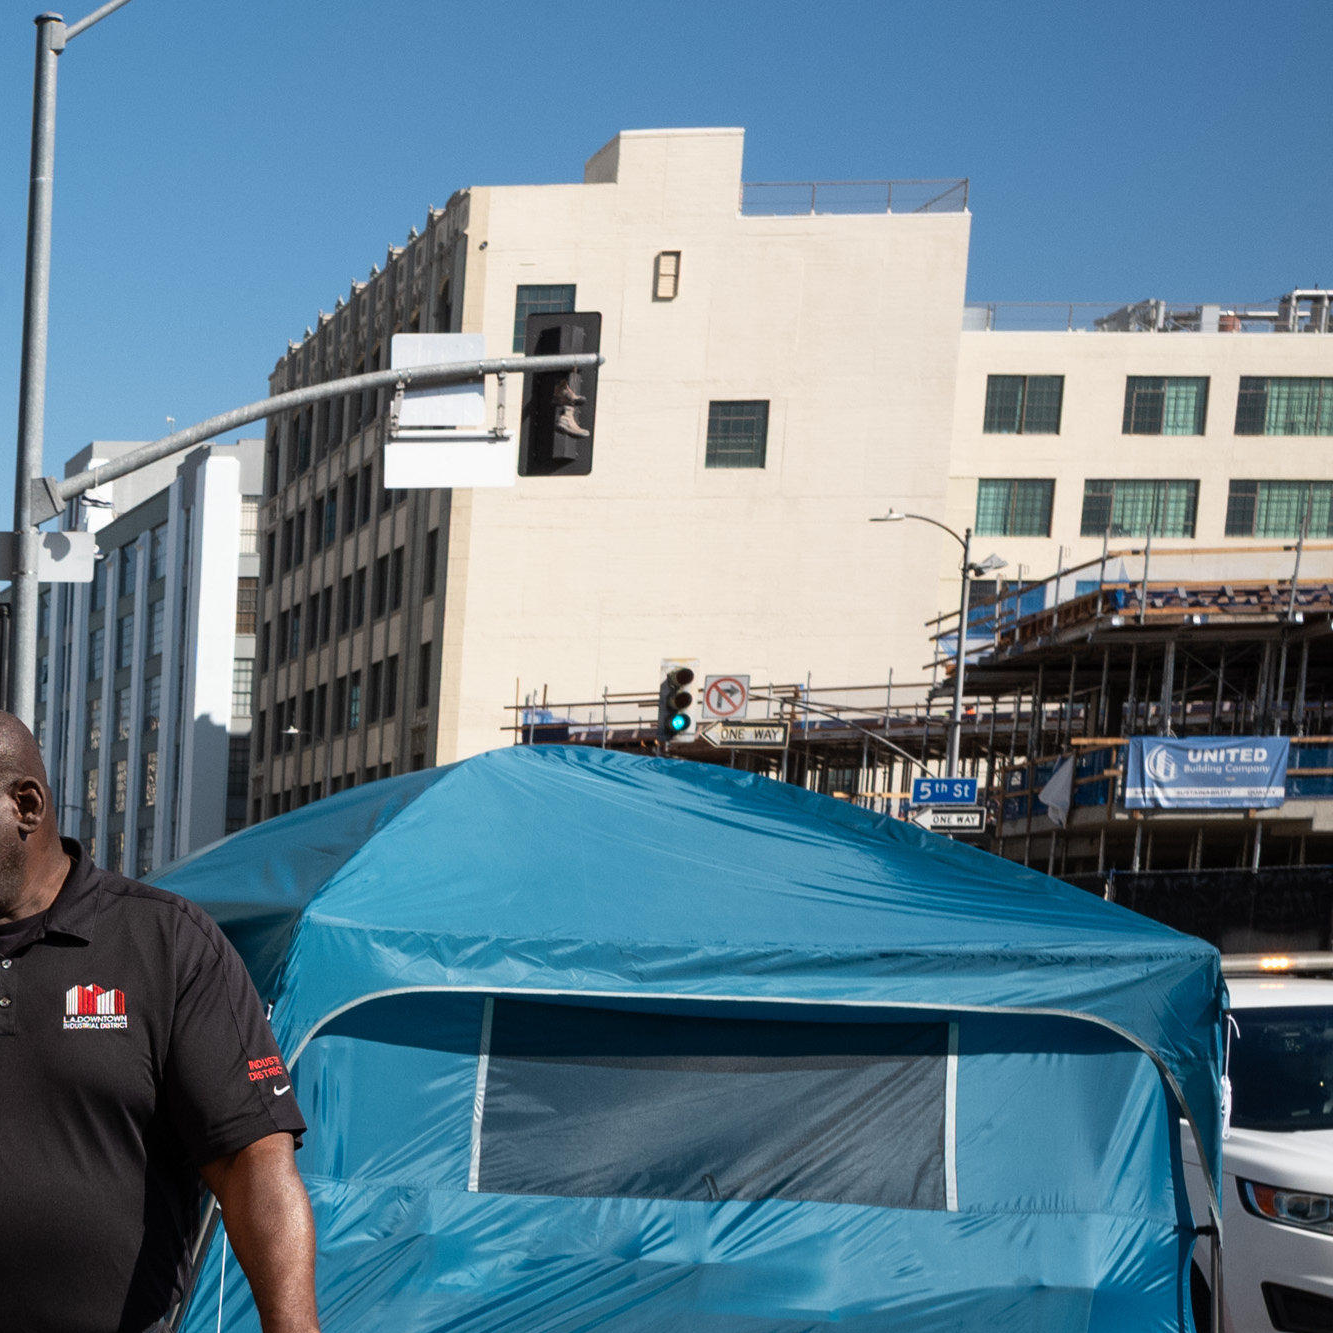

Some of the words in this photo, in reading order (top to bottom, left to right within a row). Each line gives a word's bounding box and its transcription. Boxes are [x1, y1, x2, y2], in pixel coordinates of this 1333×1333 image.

[720, 727, 745, 740] ONE
[754, 728, 780, 740] WAY
[1187, 748, 1268, 763] UNITED
[1184, 764, 1222, 775] Building
[1225, 764, 1271, 775] Company
[919, 782, 948, 800] 5th
[953, 783, 970, 798] St
[933, 815, 952, 825] ONE
[957, 815, 977, 825] WAY
